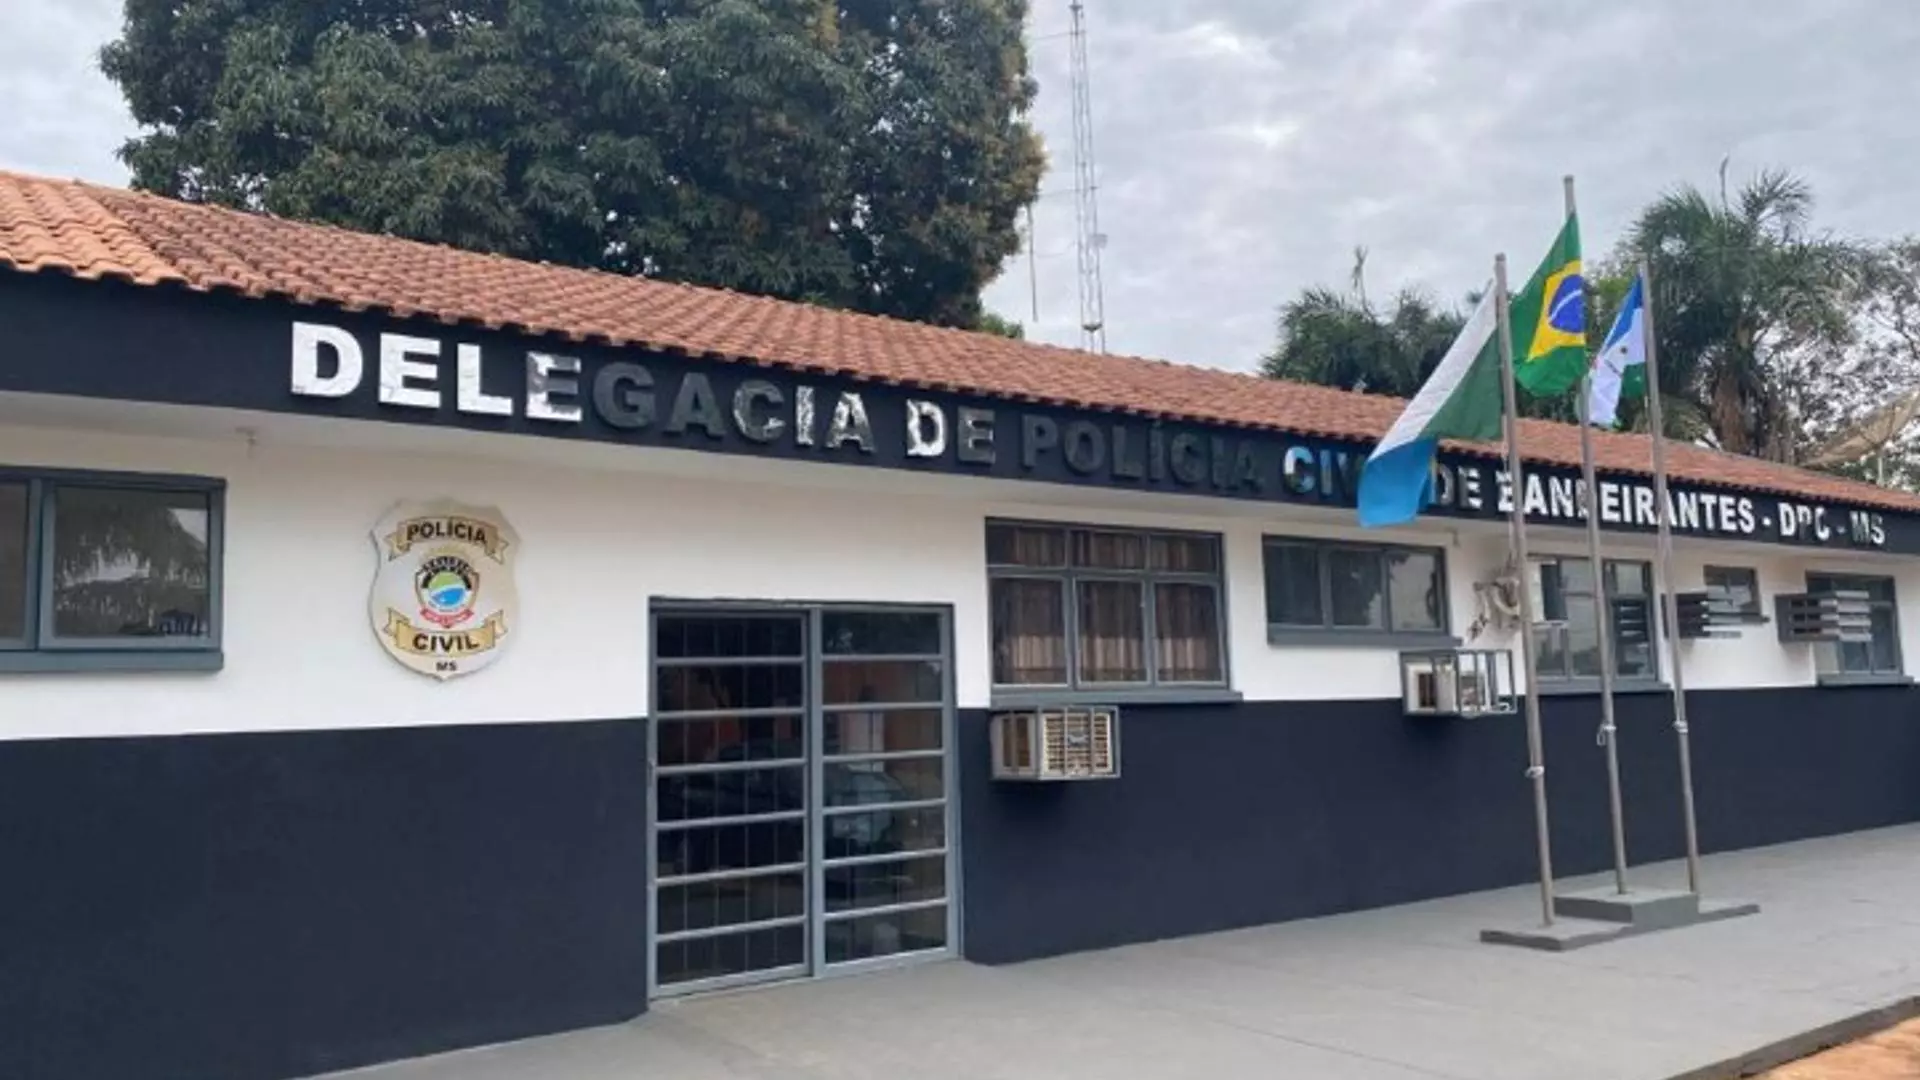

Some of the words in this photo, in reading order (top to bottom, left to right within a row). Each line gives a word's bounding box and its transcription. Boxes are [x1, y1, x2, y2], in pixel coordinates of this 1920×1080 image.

[291, 320, 875, 452] DELEGACIA
[906, 399, 996, 464] DE
[1021, 414, 1265, 490] POLÍCIA
[1283, 446, 1368, 496] CIV
[1429, 454, 1484, 510] DE
[1777, 502, 1831, 541] DPC
[1850, 511, 1885, 545] MS
[406, 521, 487, 544] POLÍCIA
[412, 633, 480, 651] CIVIL
[436, 662, 457, 672] MS
